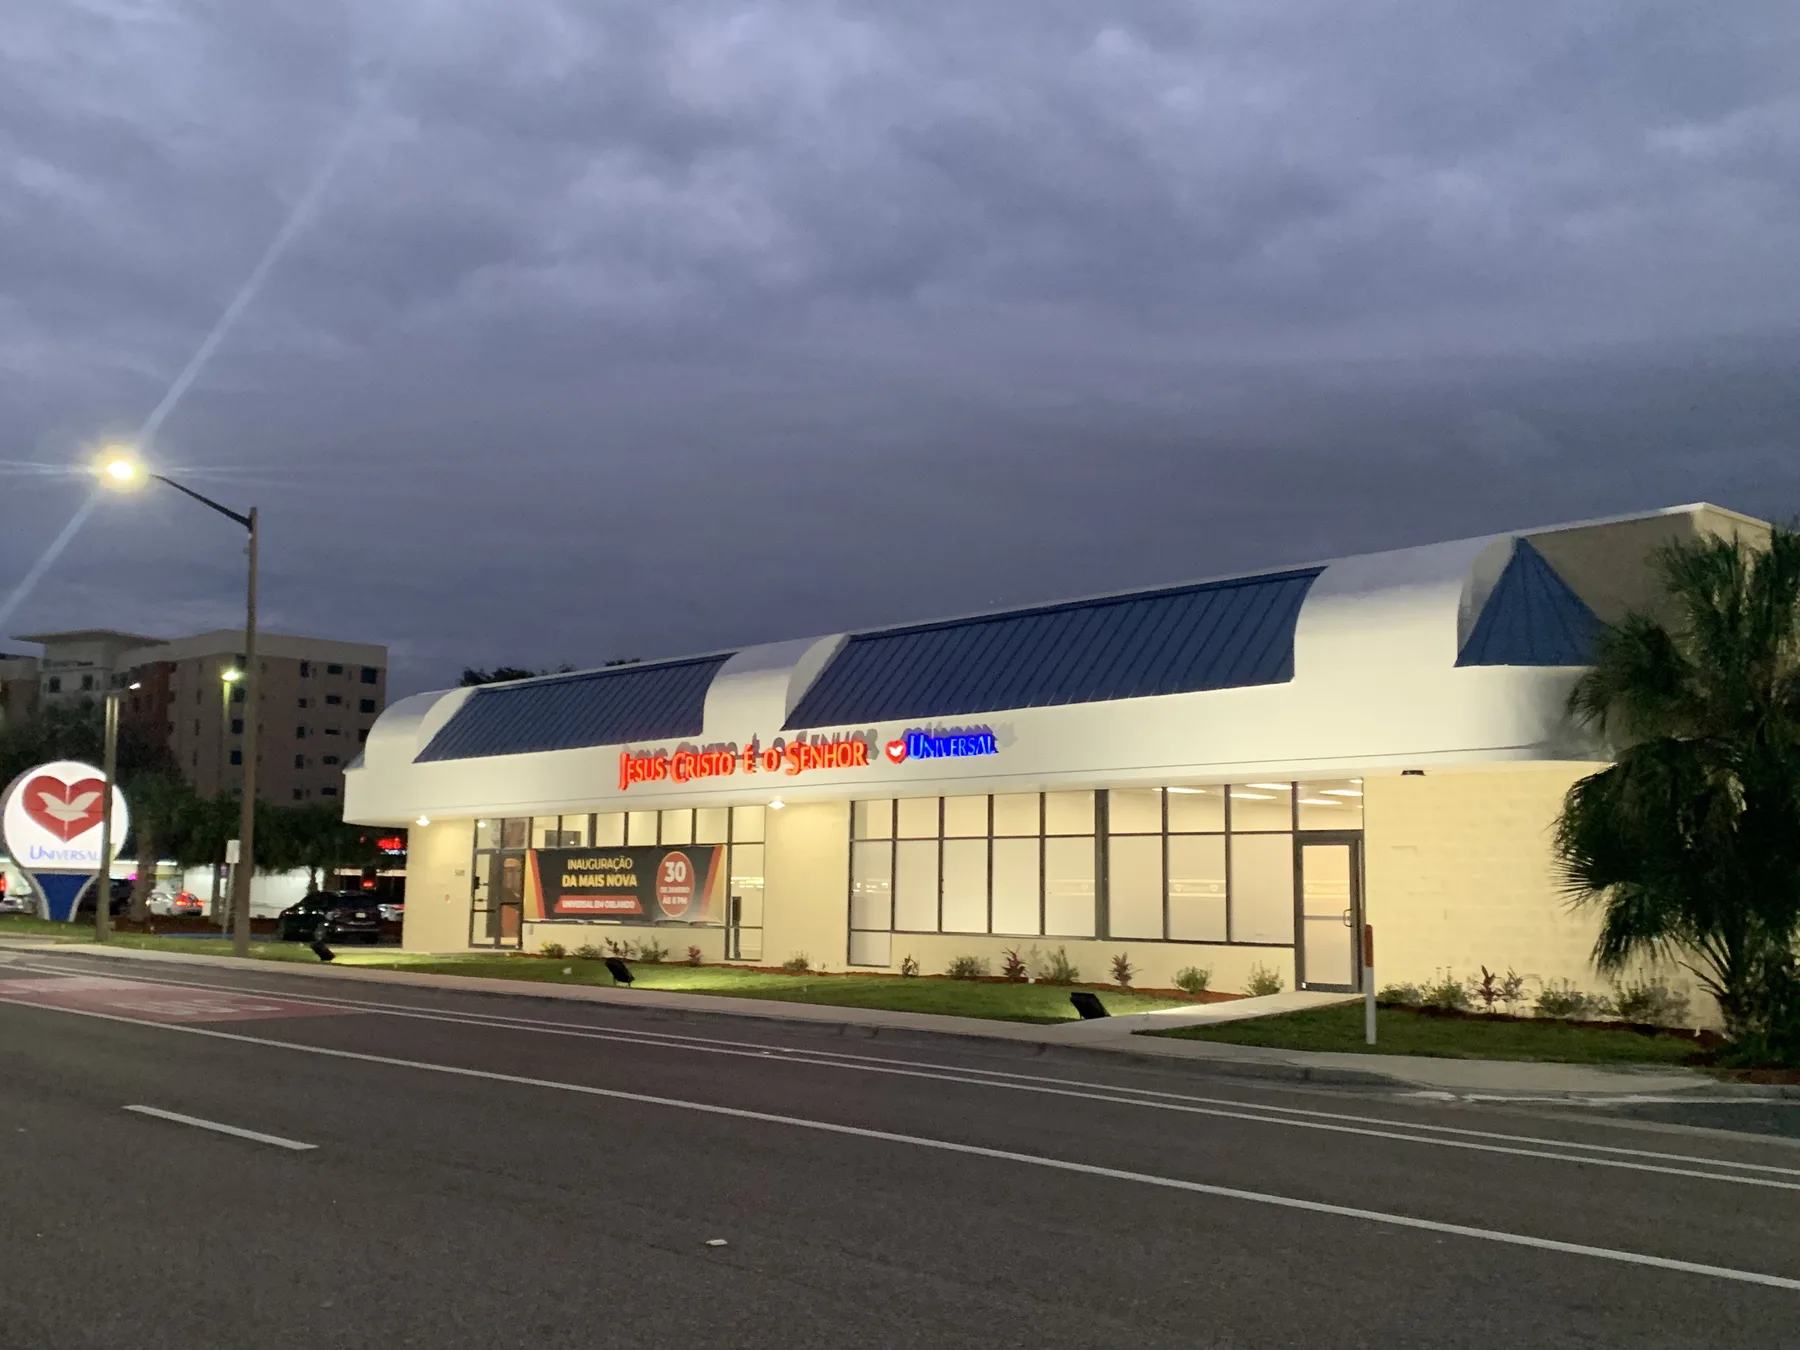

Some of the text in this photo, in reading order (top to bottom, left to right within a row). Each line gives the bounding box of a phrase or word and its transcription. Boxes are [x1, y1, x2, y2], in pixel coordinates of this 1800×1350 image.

[906, 732, 999, 761] UNIVERSAL
[619, 739, 870, 791] JESUS CRISTO É O SENHOR
[29, 845, 101, 860] UNIVERSAL
[567, 854, 633, 872] INAUGURAÇÃO
[664, 861, 687, 883] 30
[562, 873, 637, 888] DA MAIS NOVA
